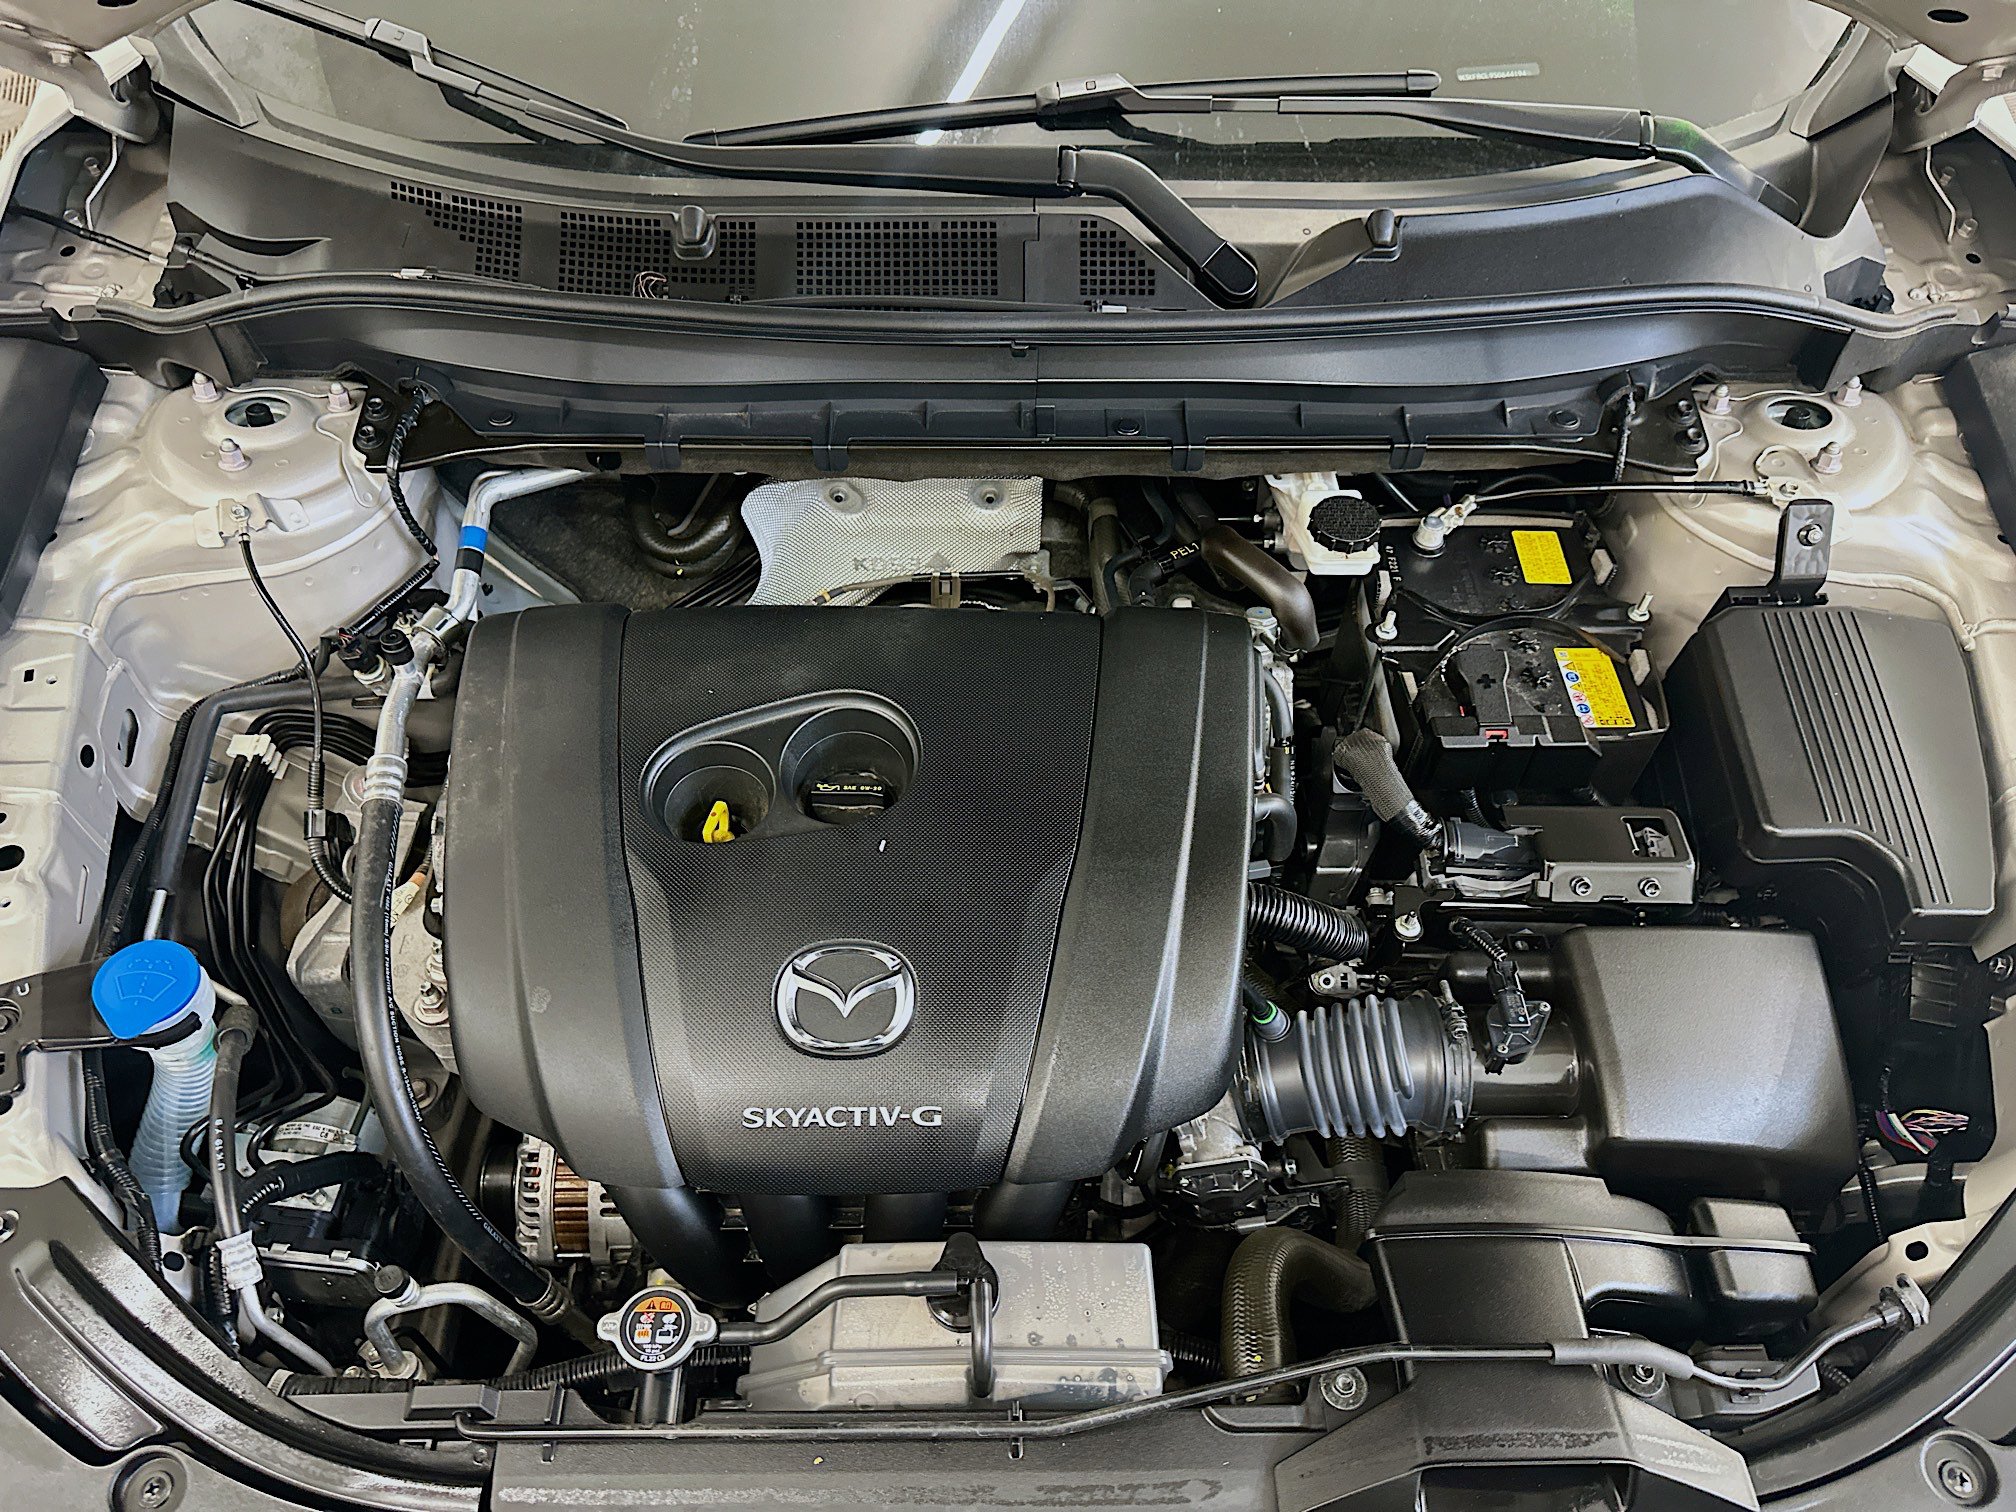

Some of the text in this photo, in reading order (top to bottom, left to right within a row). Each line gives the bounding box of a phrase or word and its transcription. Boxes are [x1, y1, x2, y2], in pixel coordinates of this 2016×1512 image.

[386, 861, 394, 892] GALAXY
[390, 1010, 400, 1043] SUCTION
[396, 1045, 405, 1066] HOSE
[742, 1106, 942, 1128] SKYACTIV-G
[694, 1320, 711, 1332] 1.1
